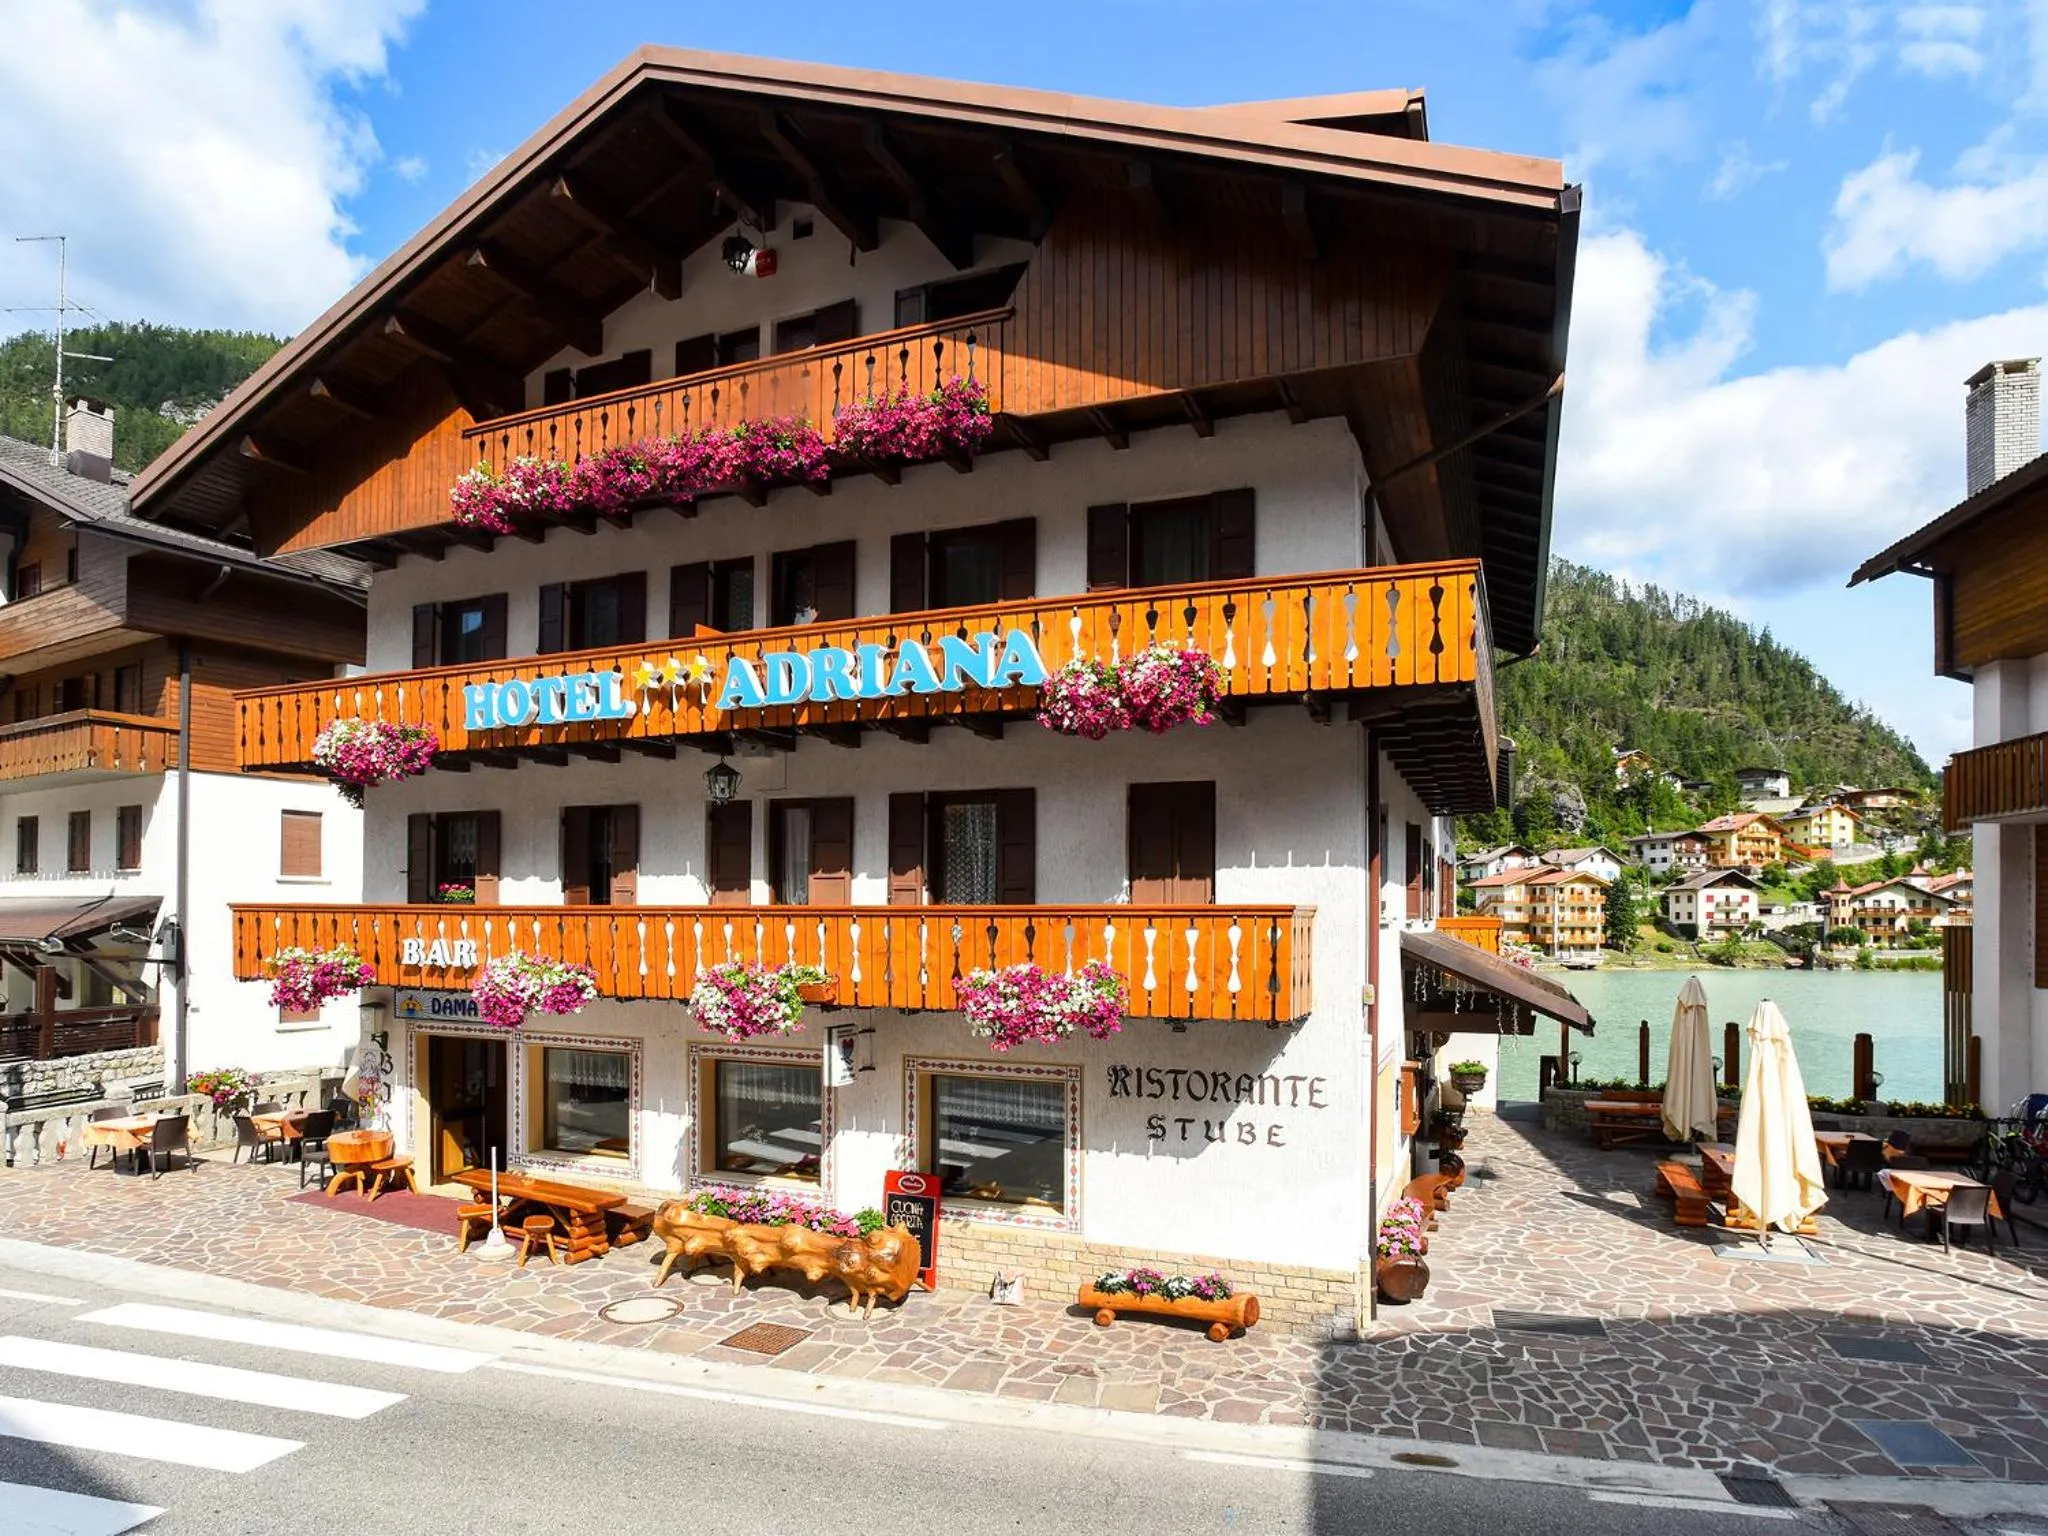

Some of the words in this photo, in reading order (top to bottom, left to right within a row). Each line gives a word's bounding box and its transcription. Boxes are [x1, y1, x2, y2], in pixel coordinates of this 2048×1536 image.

[463, 671, 636, 731] HOTEL
[715, 628, 1048, 710] ADRIANA
[401, 937, 478, 969] BAR
[1107, 1064, 1329, 1109] RISTORANTE
[1146, 1113, 1287, 1148] STUBE
